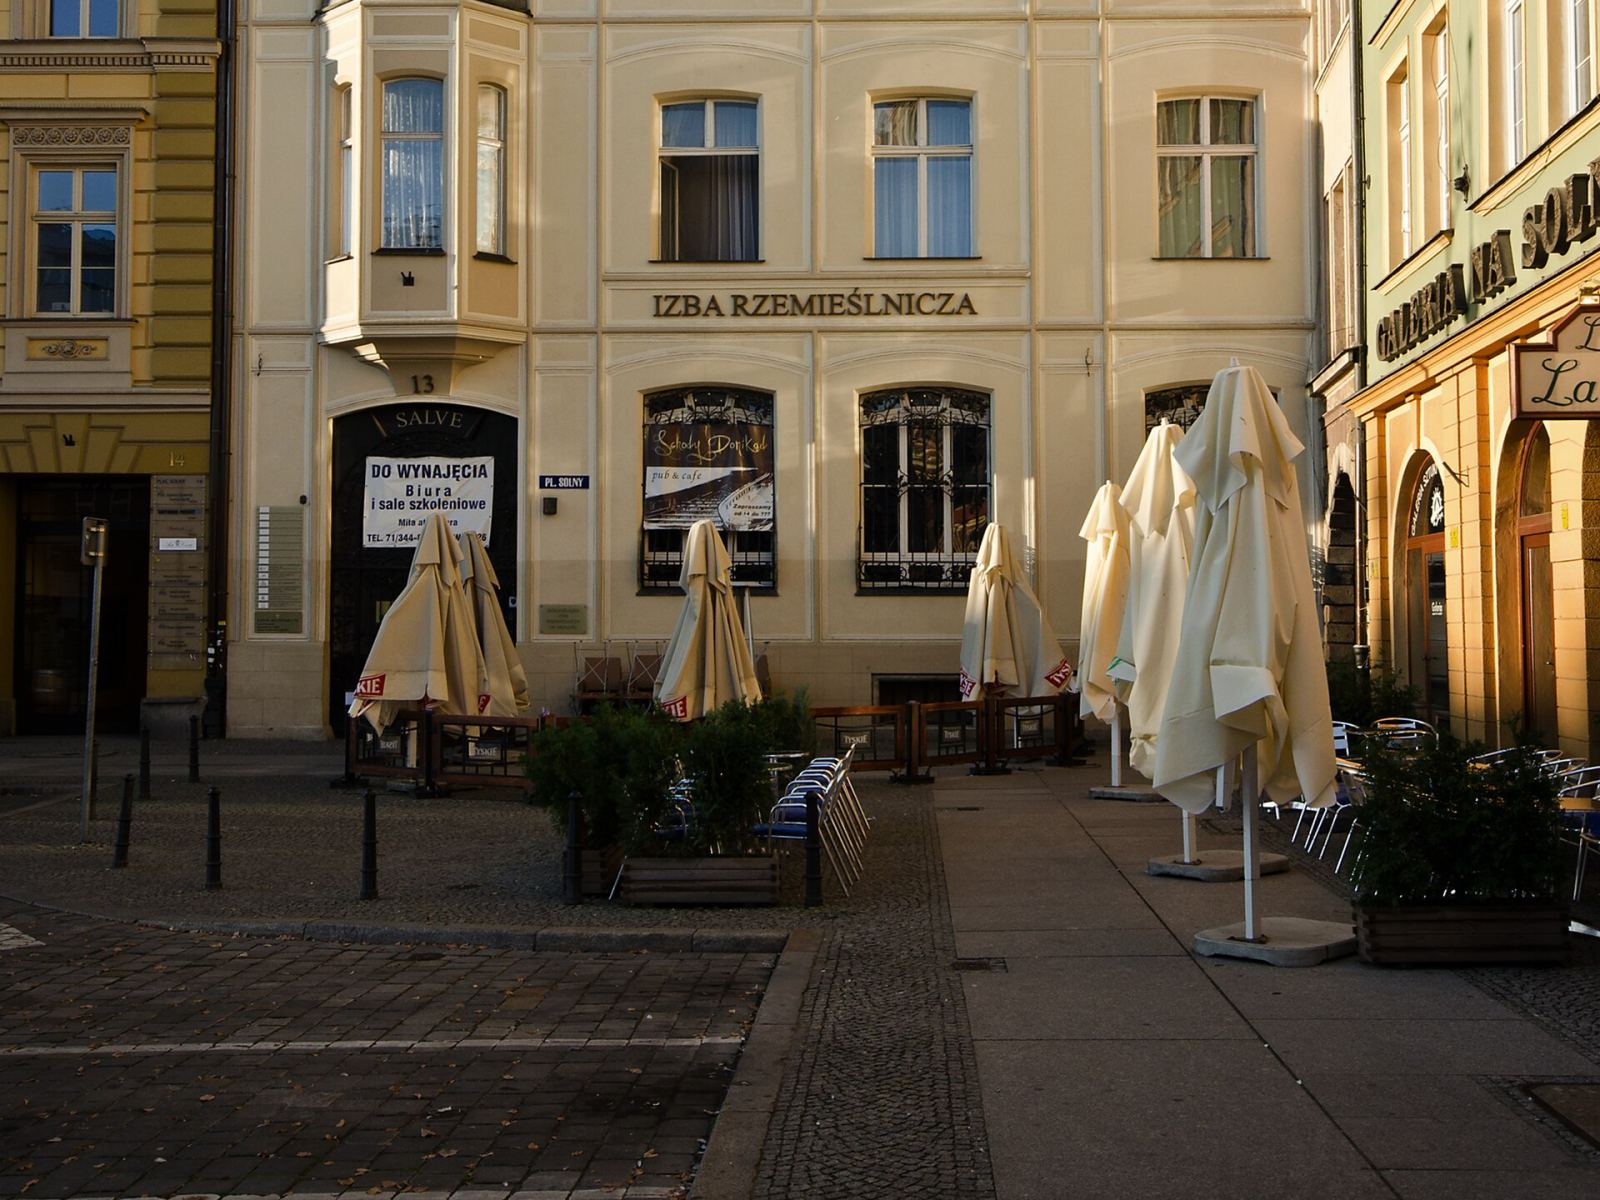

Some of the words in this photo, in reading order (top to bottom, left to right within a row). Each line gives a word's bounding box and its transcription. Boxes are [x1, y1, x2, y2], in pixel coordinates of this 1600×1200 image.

[653, 294, 725, 317] IZBA
[731, 287, 978, 317] RZEMIEŚLNICZA
[1376, 263, 1467, 362] GALERIA
[1472, 230, 1517, 305] NA
[411, 374, 435, 394] 13
[396, 410, 464, 428] SALVE
[372, 464, 391, 479] DO
[397, 464, 488, 482] WYNAJĘCIA
[652, 470, 670, 482] pub
[672, 471, 679, 480] &
[682, 470, 702, 481] cafe
[545, 477, 557, 488] PL.
[559, 477, 584, 488] SOLNY
[406, 484, 452, 497] Biura
[379, 497, 405, 510] sale
[409, 497, 486, 510] szkoleniowe
[367, 534, 384, 543] TEL.
[843, 734, 868, 744] TYSKIE
[473, 746, 497, 757] YSKIE
